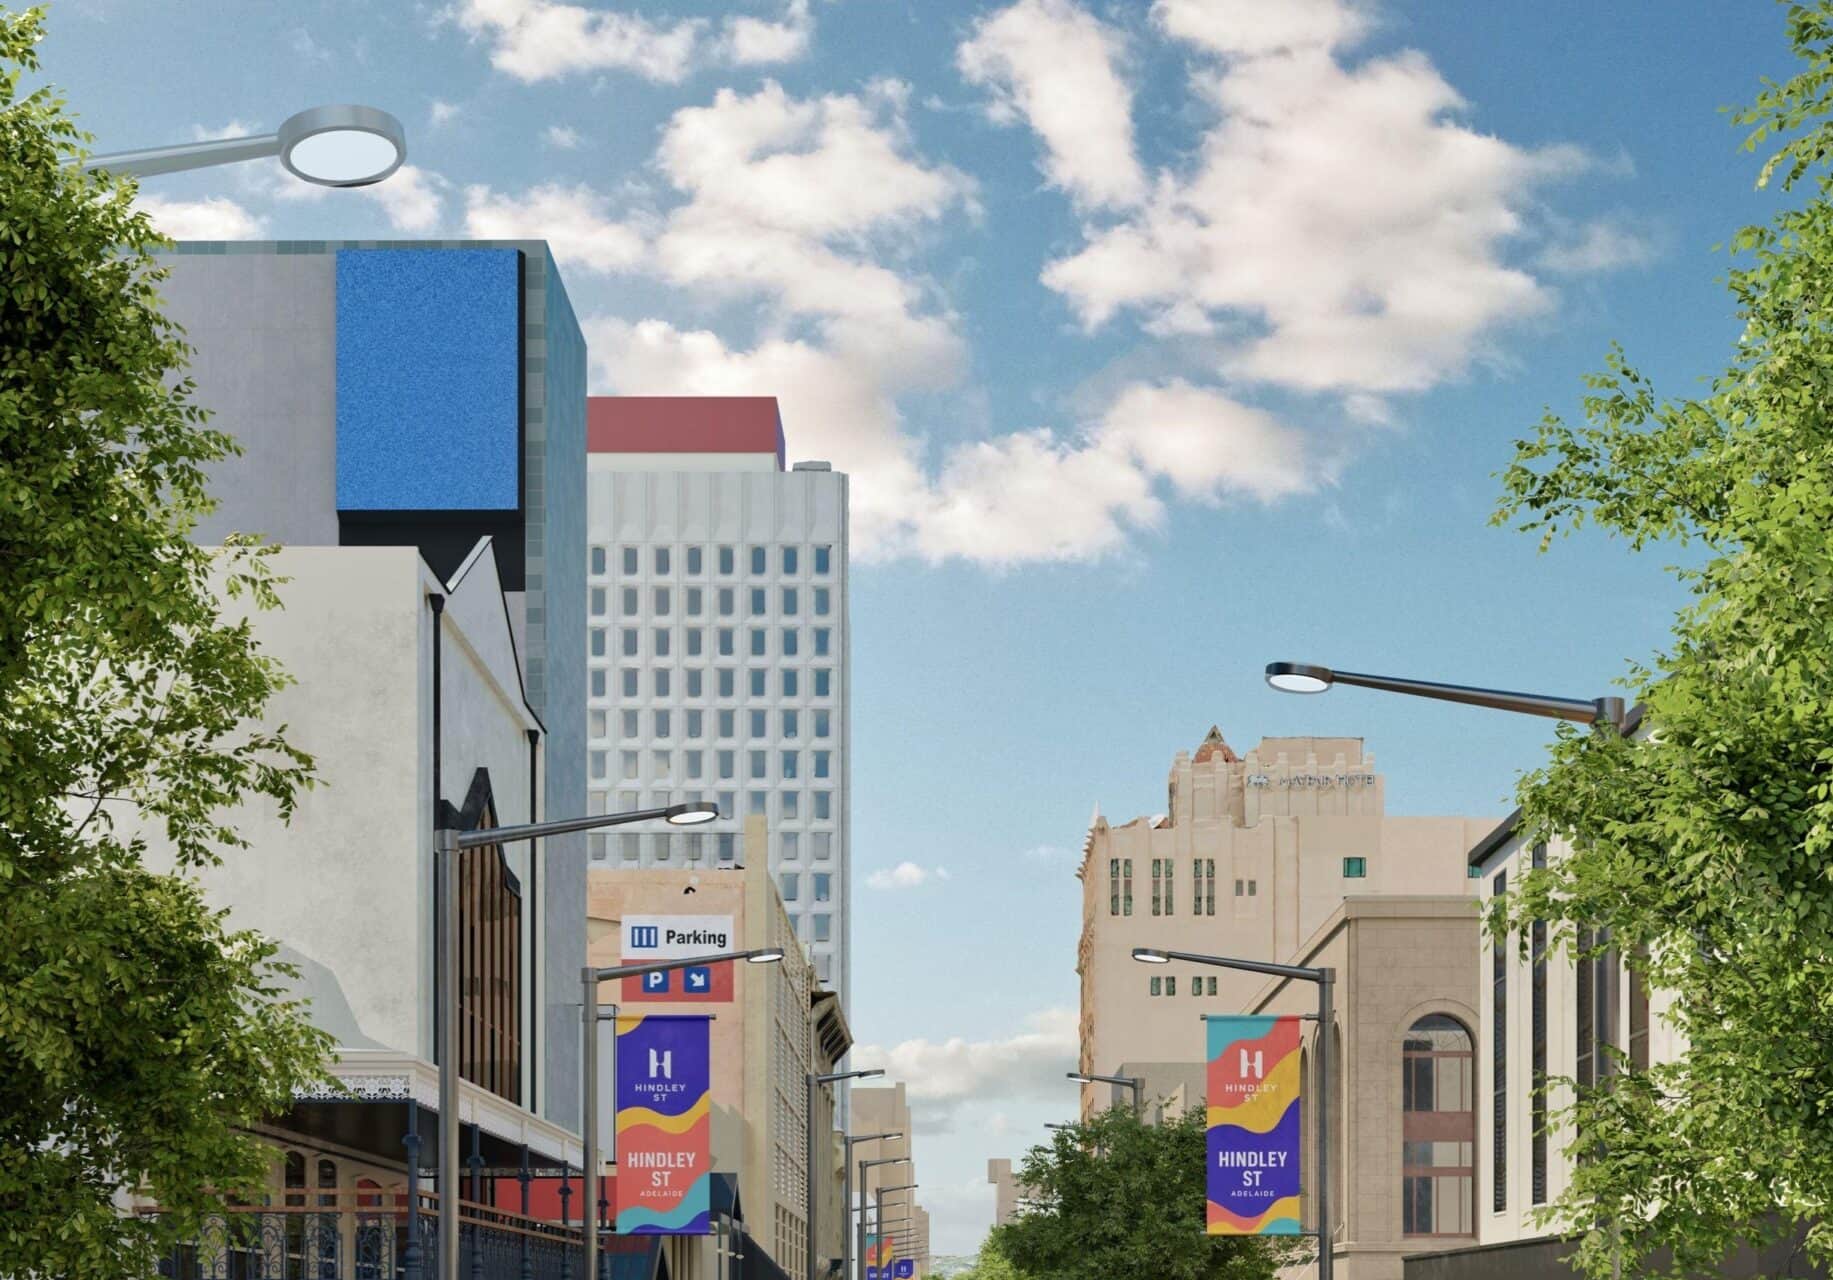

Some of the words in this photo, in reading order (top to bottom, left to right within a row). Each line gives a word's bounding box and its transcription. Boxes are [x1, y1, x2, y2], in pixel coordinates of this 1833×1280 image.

[666, 929, 727, 948] Parking
[649, 971, 663, 988] P
[635, 1084, 686, 1092] HINDLEY
[1225, 1083, 1279, 1093] HINDLEY
[653, 1093, 667, 1102] ST
[1244, 1094, 1258, 1102] ST
[627, 1152, 696, 1168] HINDLEY
[1218, 1151, 1287, 1168] HINDLEY
[651, 1171, 671, 1187] ST
[1242, 1170, 1262, 1187] ST
